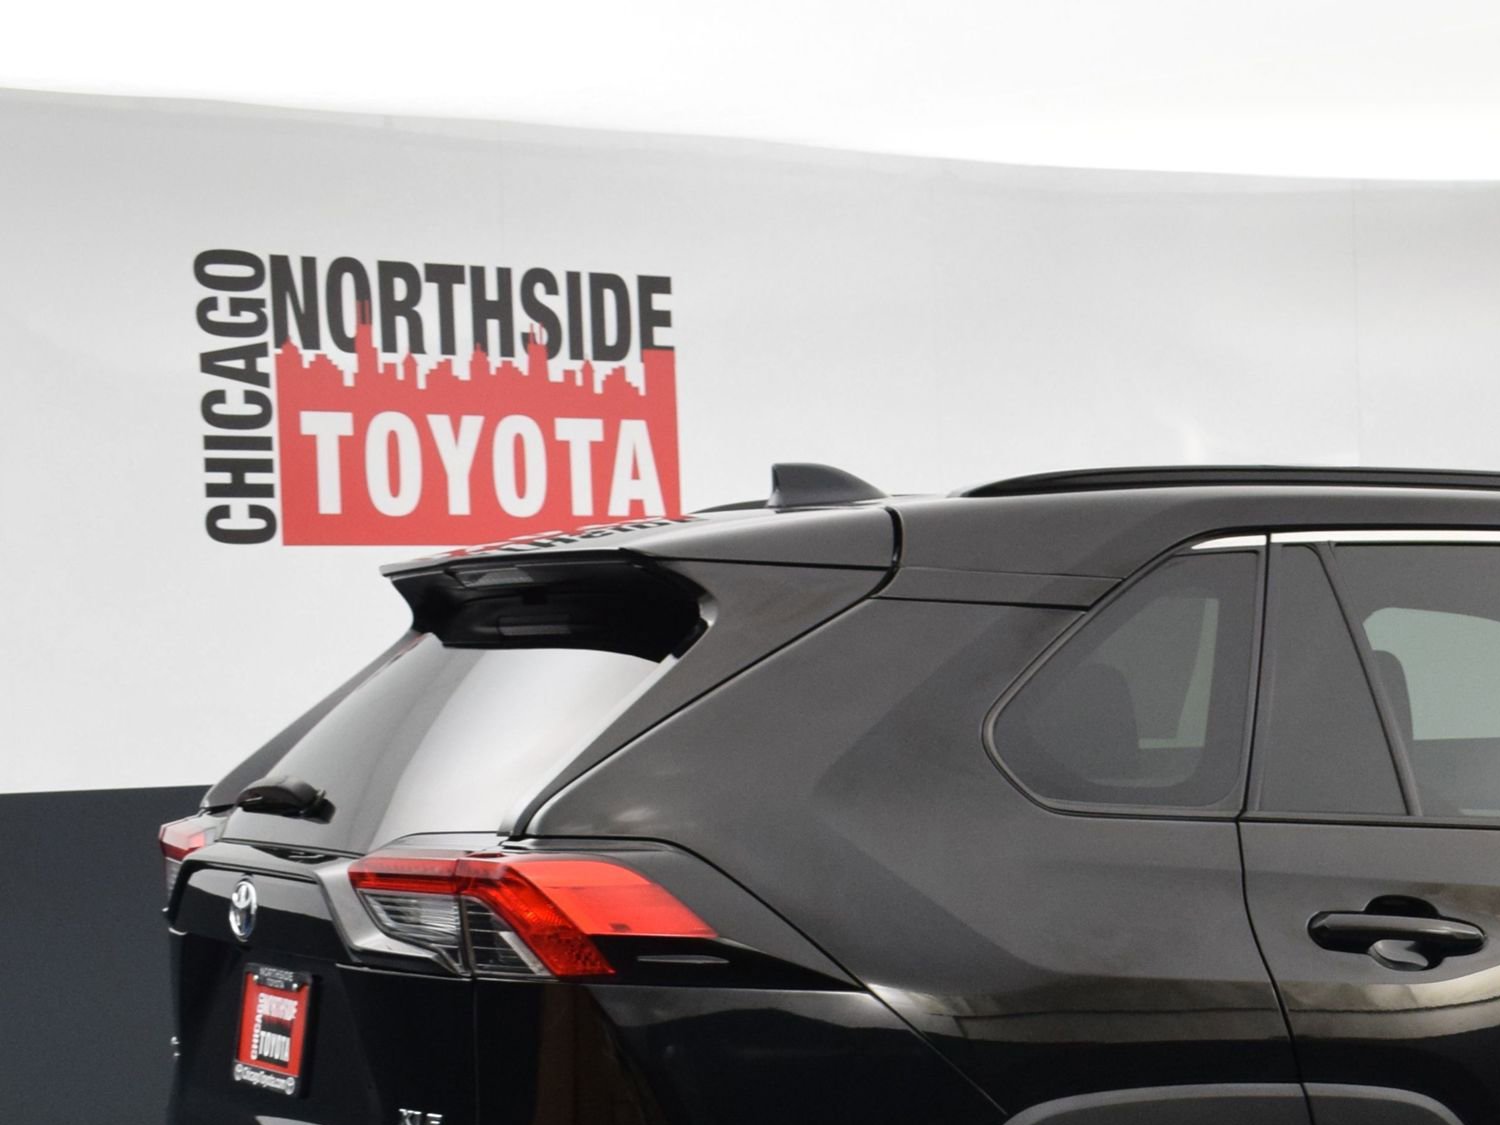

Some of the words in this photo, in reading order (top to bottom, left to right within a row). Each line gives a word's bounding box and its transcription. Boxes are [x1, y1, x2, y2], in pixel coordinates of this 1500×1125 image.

[268, 253, 674, 362] NORTHSIDE
[193, 248, 278, 545] CHICAGO
[300, 409, 667, 518] TOYOTA
